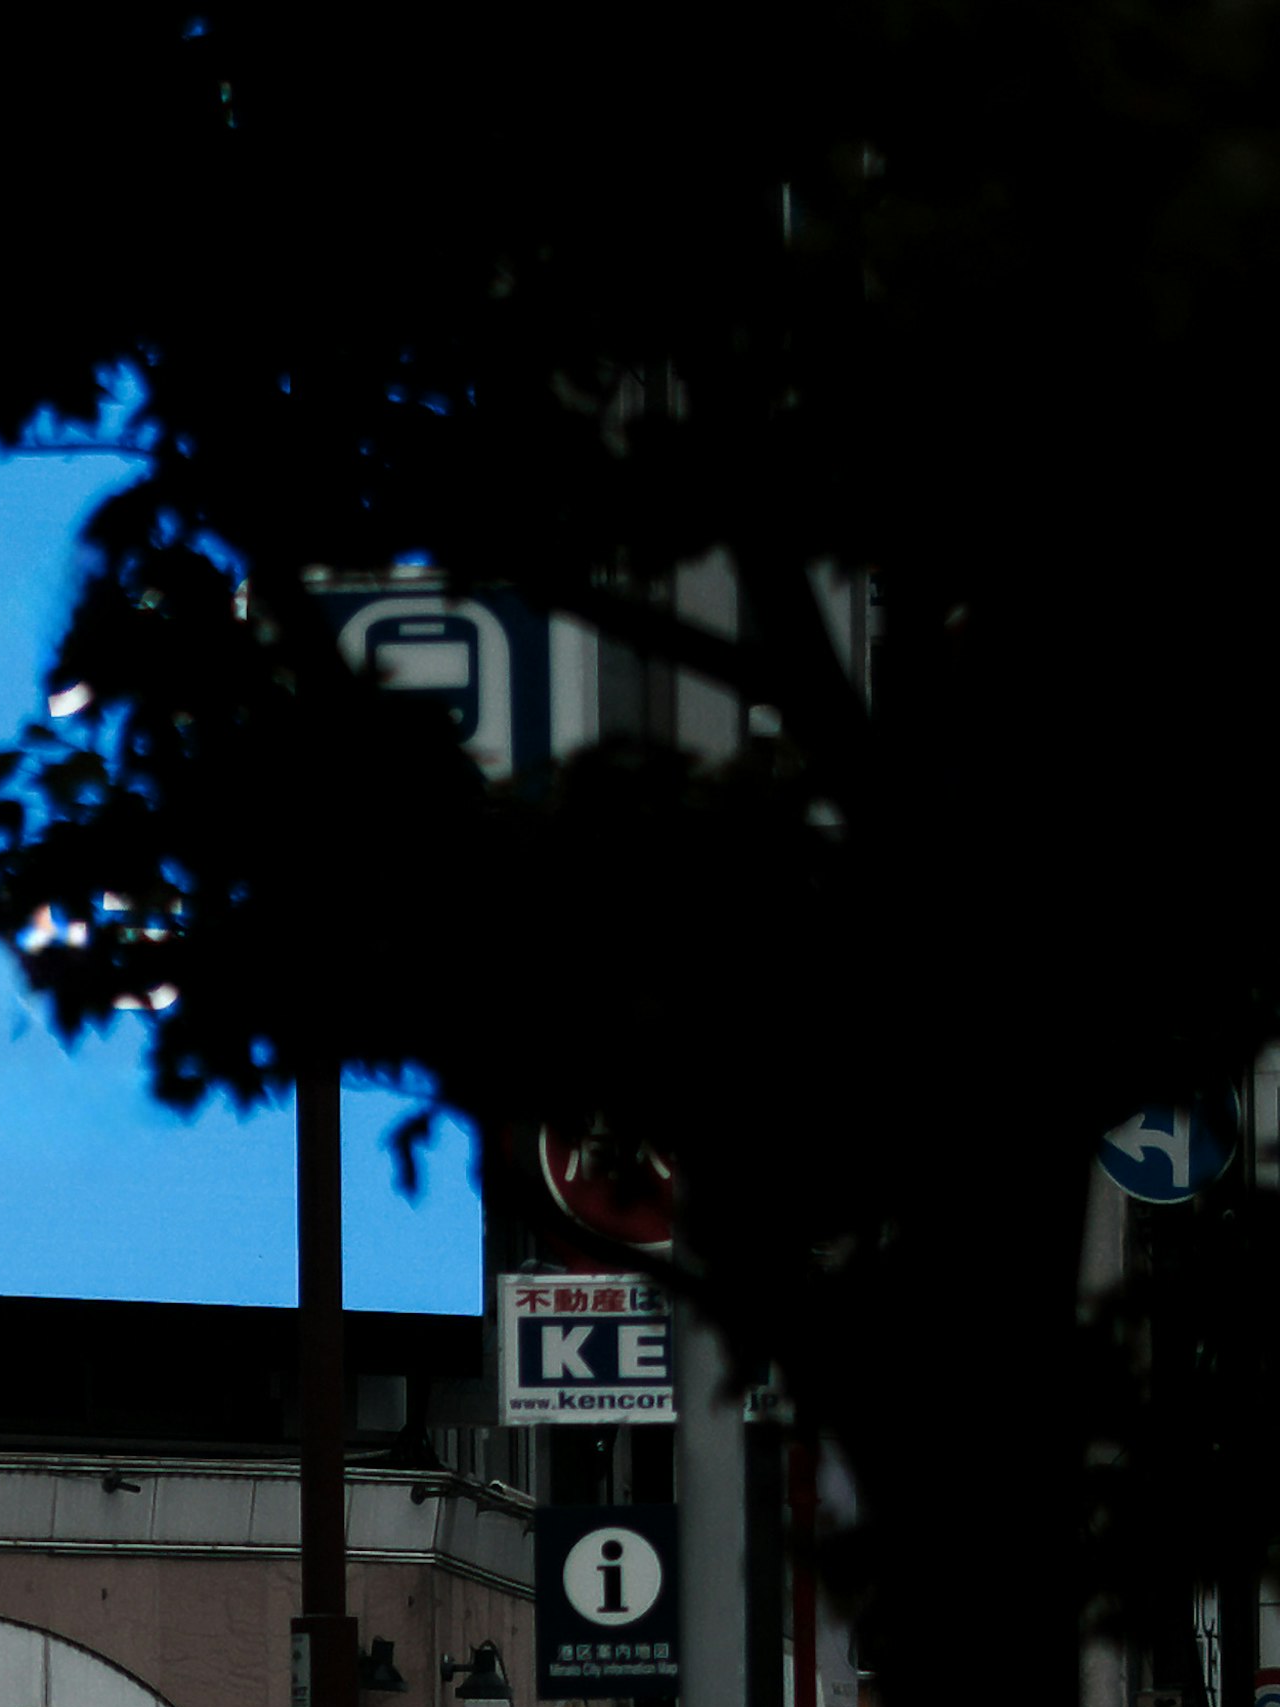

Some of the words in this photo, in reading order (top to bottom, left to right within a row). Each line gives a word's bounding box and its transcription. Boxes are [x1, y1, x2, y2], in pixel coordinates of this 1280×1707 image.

[515, 1287, 670, 1314] 不動産は
[509, 1390, 676, 1412] www.kencor
[557, 1642, 670, 1662] 港区案内地図
[583, 1662, 602, 1679] City
[657, 1661, 679, 1677] Map
